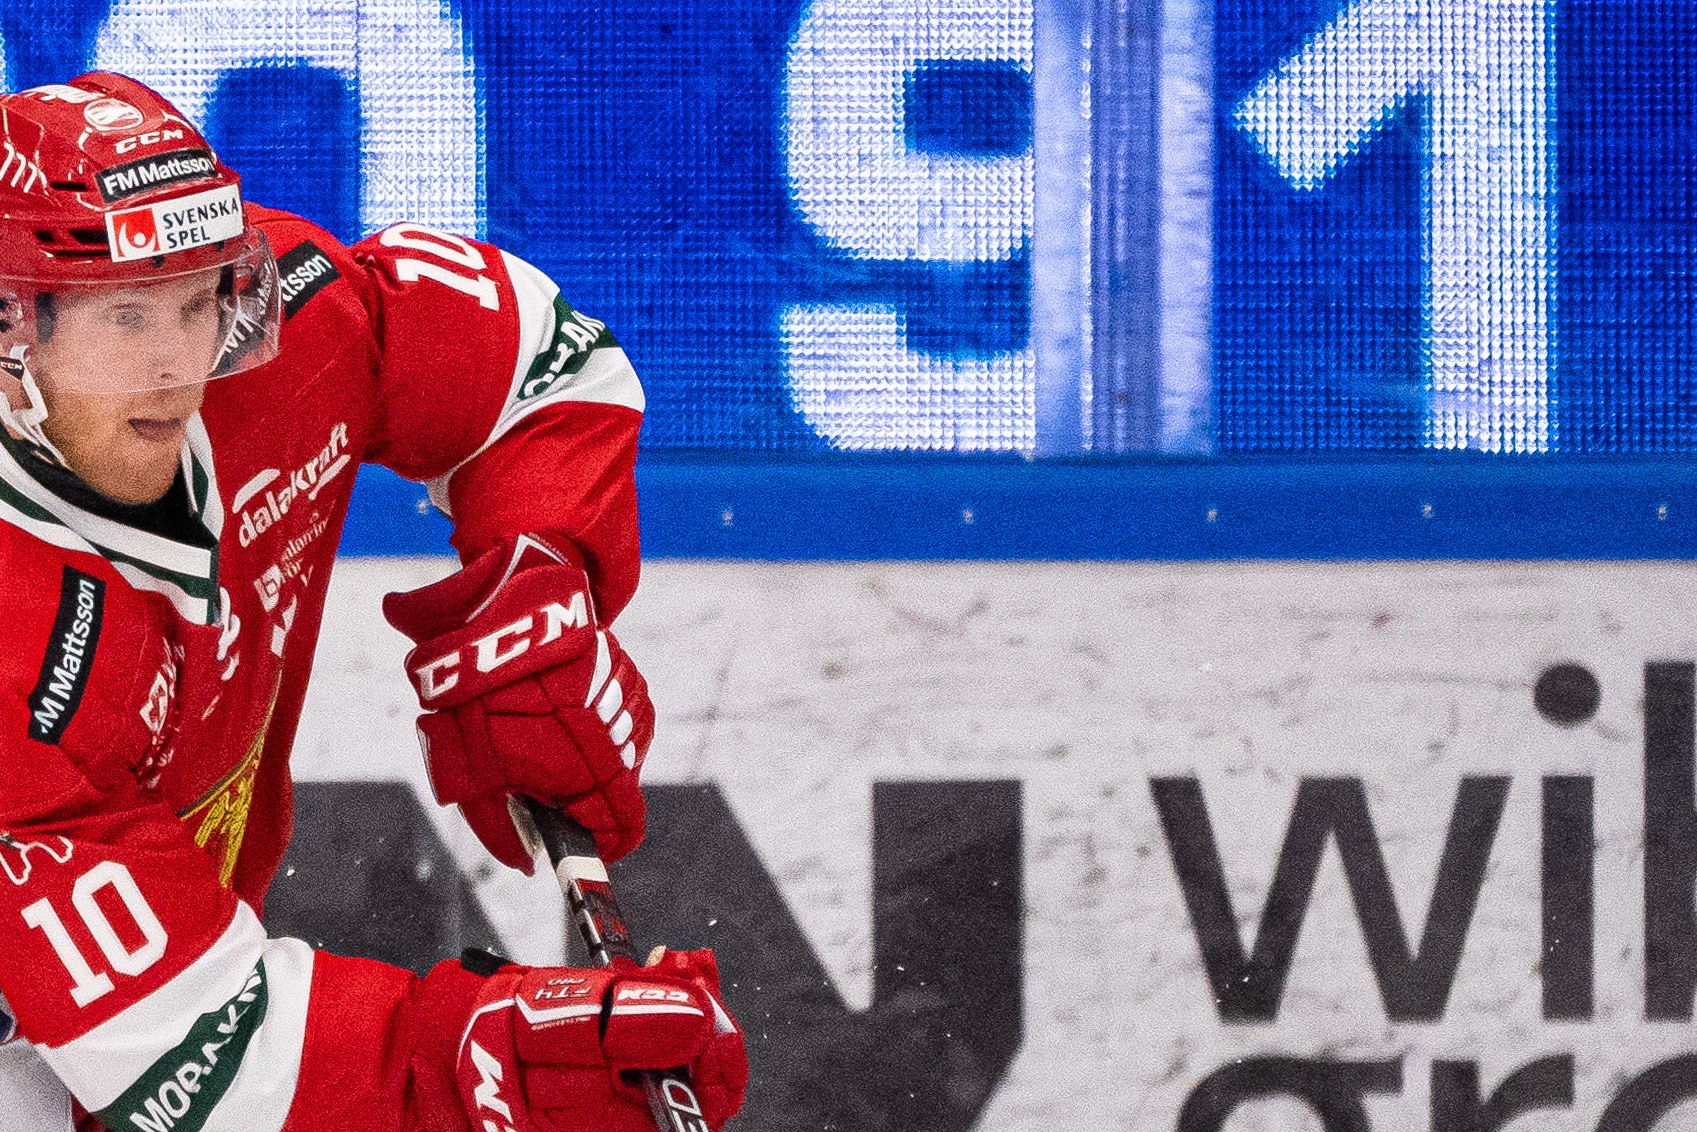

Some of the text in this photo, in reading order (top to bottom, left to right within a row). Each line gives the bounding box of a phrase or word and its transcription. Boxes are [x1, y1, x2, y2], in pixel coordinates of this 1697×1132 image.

[114, 129, 184, 155] CCM
[103, 170, 139, 195] FM
[162, 197, 240, 230] SVENSKA
[166, 228, 211, 250] SPEL
[239, 422, 350, 548] dalakraft
[47, 577, 98, 693] Mattsson
[414, 591, 589, 701] CCM
[20, 860, 169, 1009] 10
